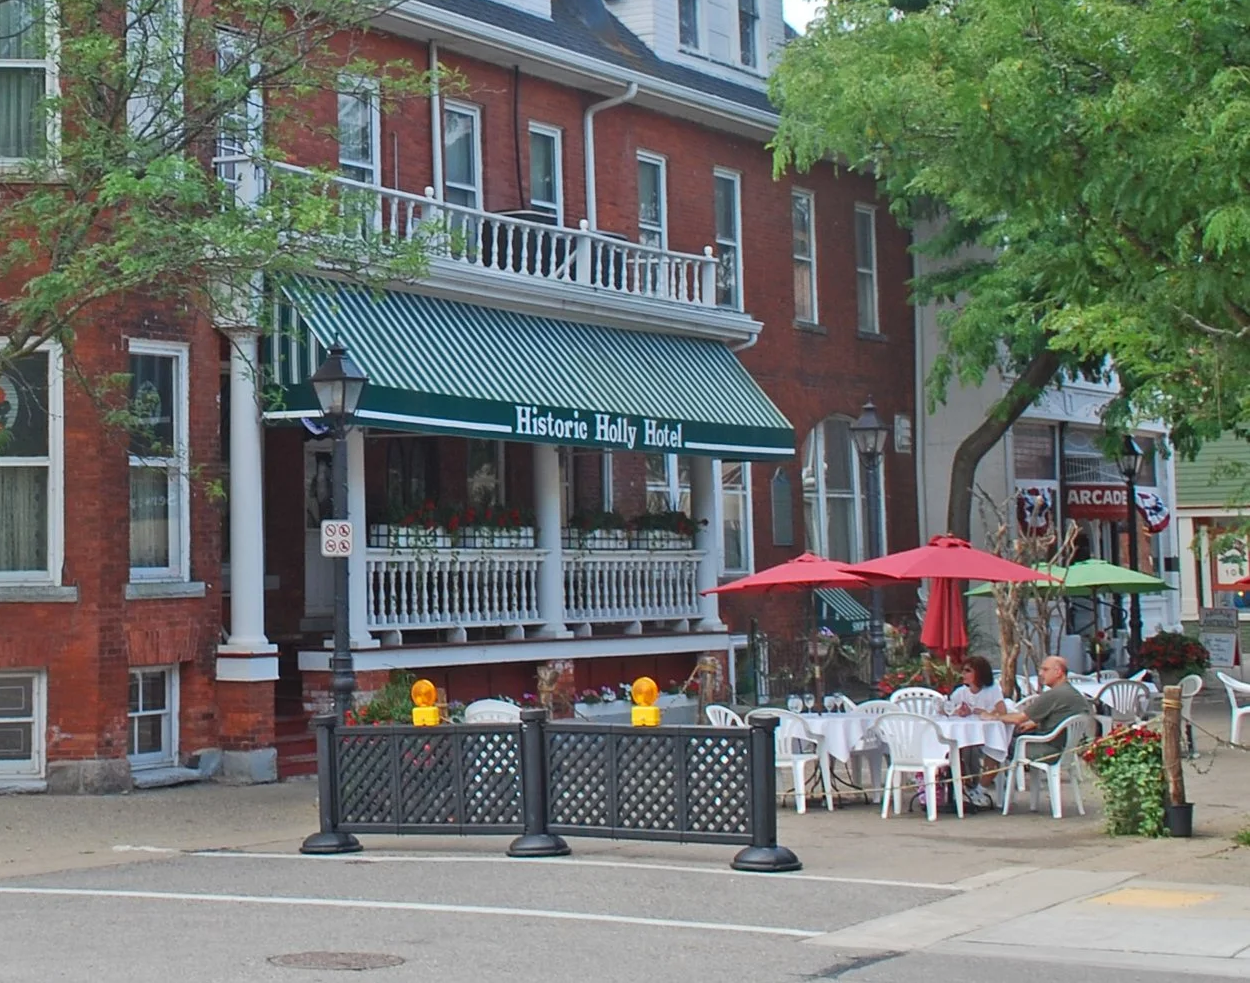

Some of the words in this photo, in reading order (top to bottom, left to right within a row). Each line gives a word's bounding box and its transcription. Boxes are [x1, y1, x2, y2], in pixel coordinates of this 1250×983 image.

[515, 405, 588, 440] Historic
[594, 412, 637, 450] Holly
[643, 418, 683, 448] Hotel
[1067, 489, 1128, 505] ARCADE
